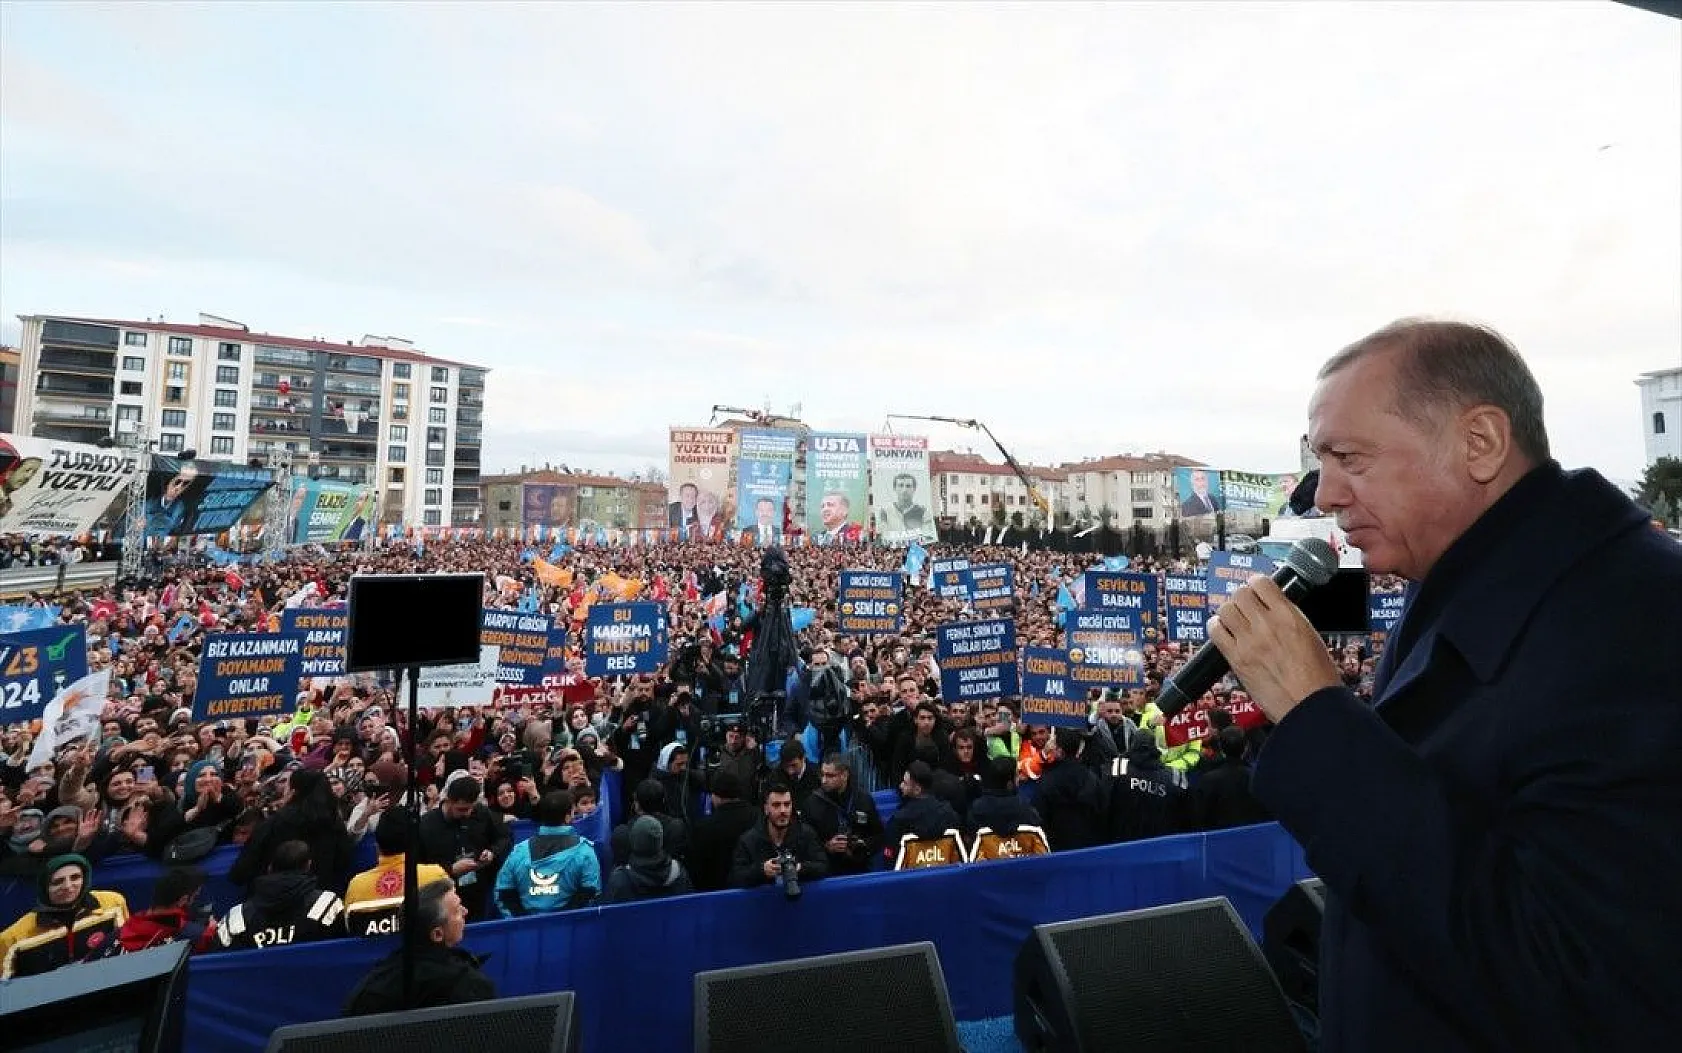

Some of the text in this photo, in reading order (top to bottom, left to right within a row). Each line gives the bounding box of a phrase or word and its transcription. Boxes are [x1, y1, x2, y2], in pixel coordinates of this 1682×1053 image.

[814, 438, 860, 452] USTA
[1130, 580, 1146, 594] DA
[854, 599, 886, 616] SENİ DE
[1102, 594, 1141, 609] BABAM
[484, 612, 518, 628] HARPUT
[613, 608, 632, 622] BU
[207, 638, 299, 658] BİZ KAZANMAYA
[1084, 644, 1109, 664] SENİ
[607, 654, 636, 670] REİS
[228, 677, 269, 695] ONLAR
[1044, 680, 1066, 696] AMA
[915, 845, 946, 864] ACİL
